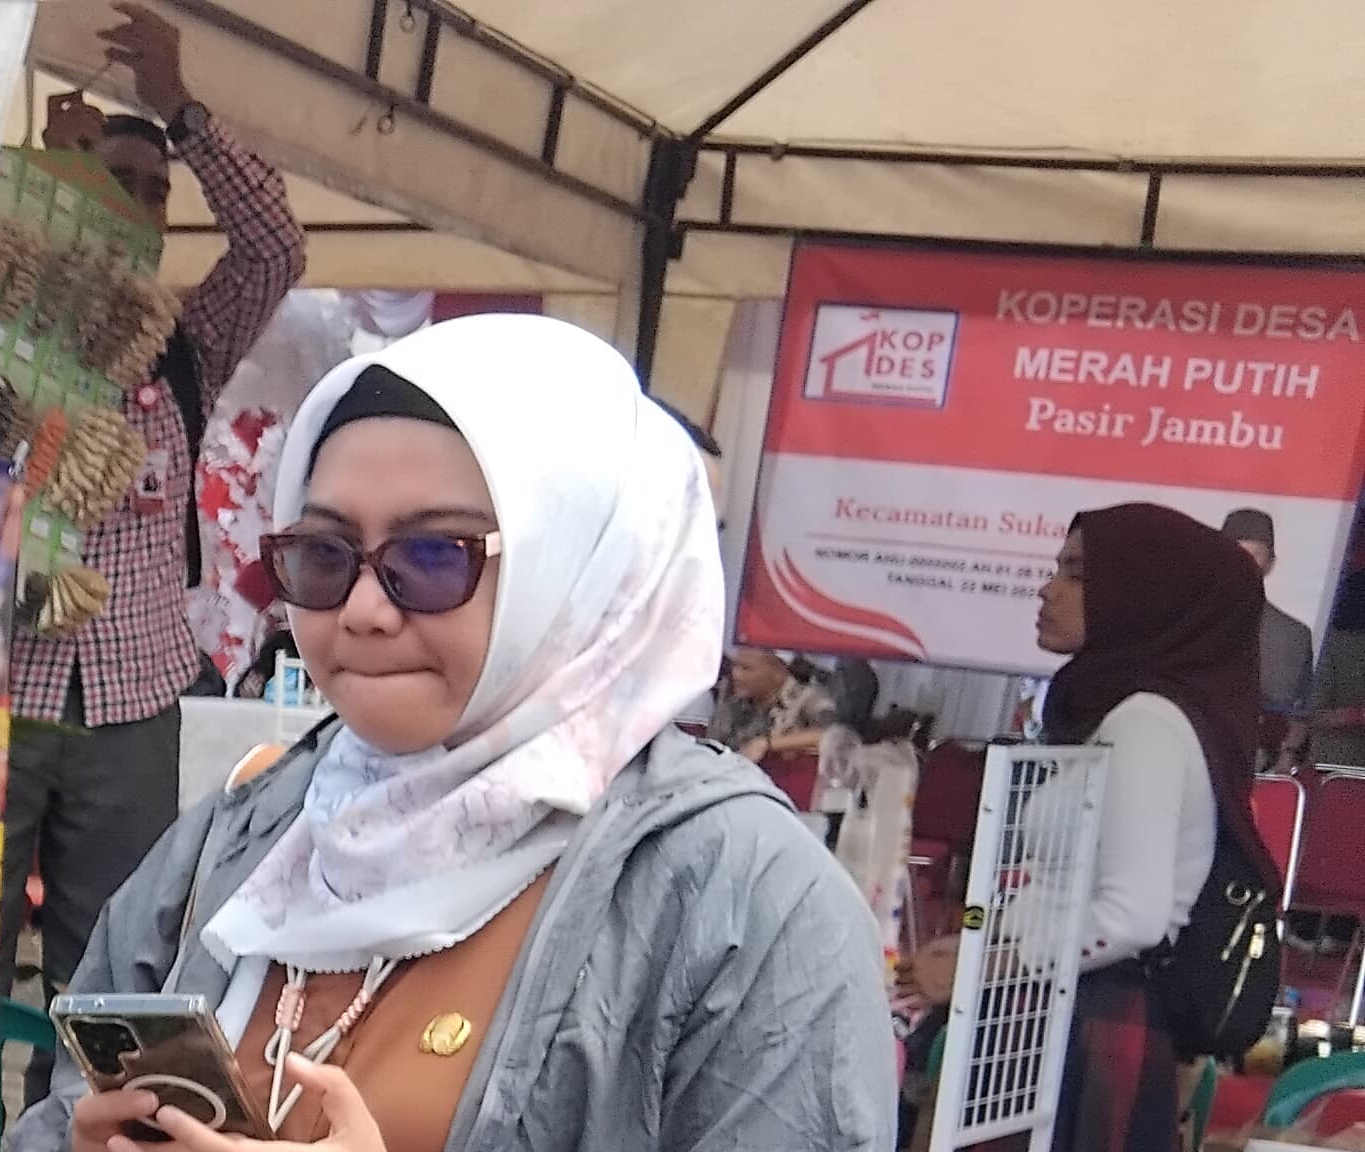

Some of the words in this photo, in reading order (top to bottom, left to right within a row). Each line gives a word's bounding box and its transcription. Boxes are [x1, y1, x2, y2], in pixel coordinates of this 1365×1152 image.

[996, 289, 1222, 334] KOPERASI
[1233, 303, 1360, 342] DESA
[879, 328, 945, 351] KOP
[875, 355, 936, 379] DES
[1014, 346, 1172, 389] MERAH
[1182, 358, 1321, 400] PUTIH
[1024, 397, 1135, 438] Pasir
[1141, 406, 1285, 450] Jambu
[834, 498, 989, 531] Kecamatan
